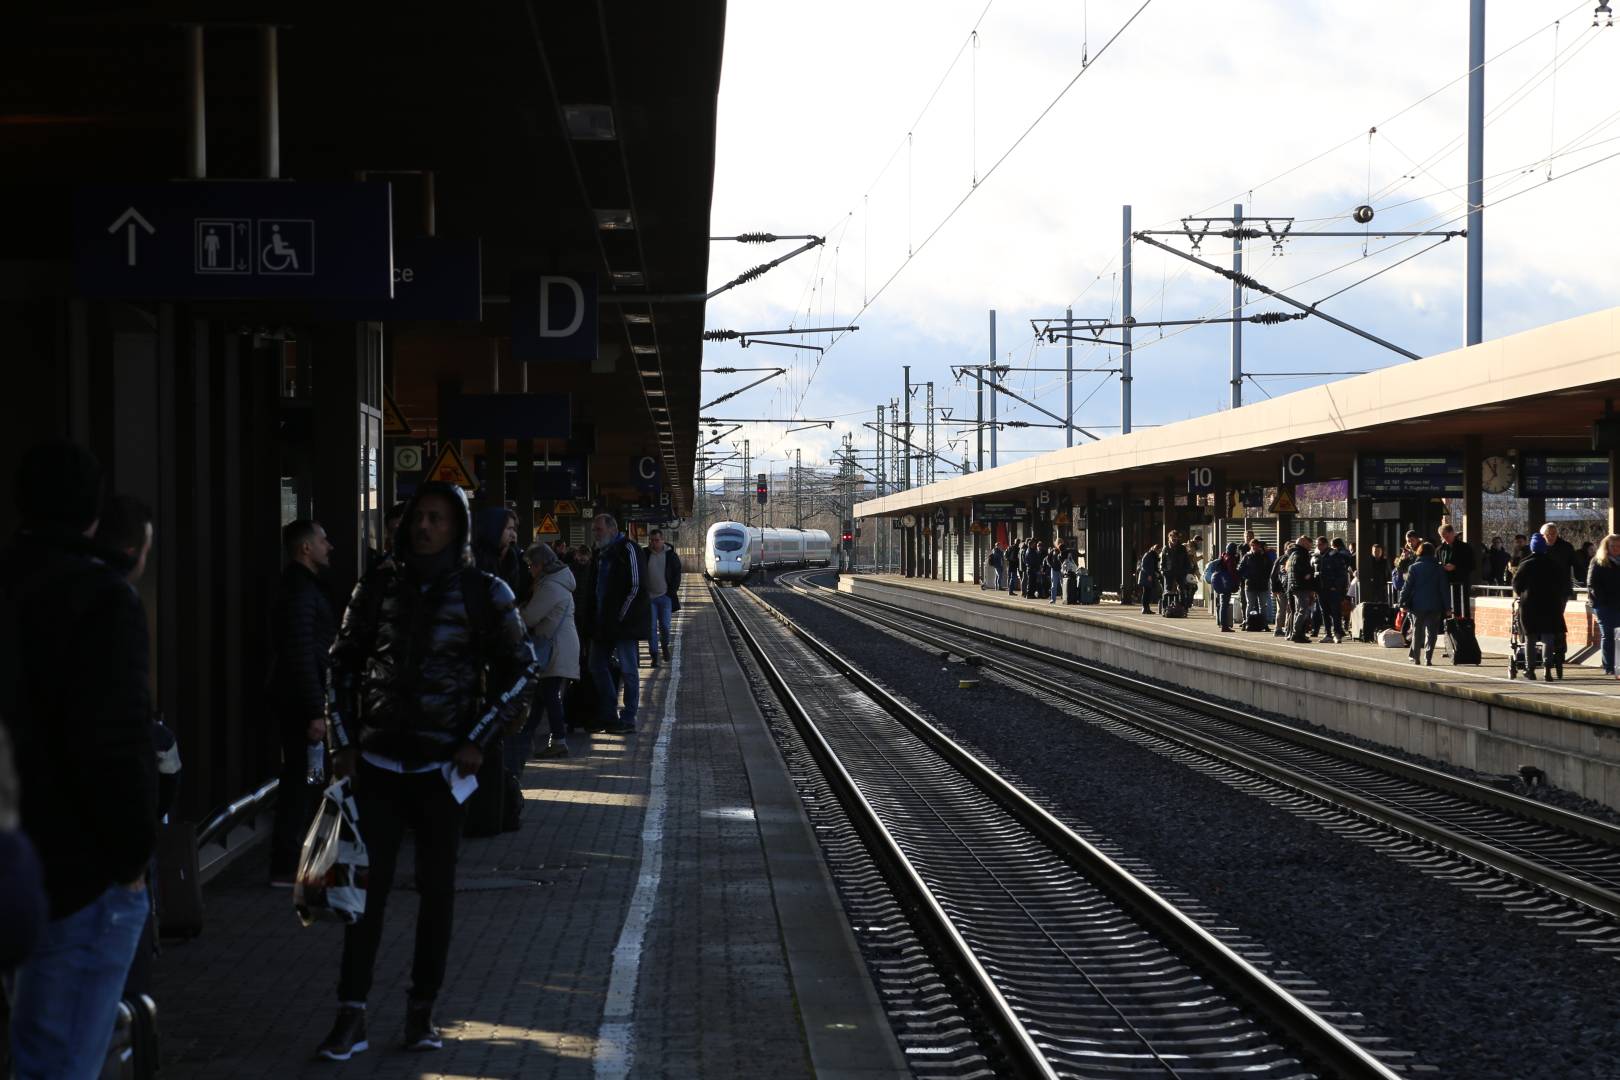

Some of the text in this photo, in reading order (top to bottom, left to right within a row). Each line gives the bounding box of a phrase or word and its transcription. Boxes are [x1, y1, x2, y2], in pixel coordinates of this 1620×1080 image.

[538, 275, 585, 338] D
[423, 440, 439, 457] 11
[638, 456, 656, 479] C
[1288, 453, 1306, 476] C
[1191, 467, 1213, 487] 10
[1040, 490, 1050, 504] B
